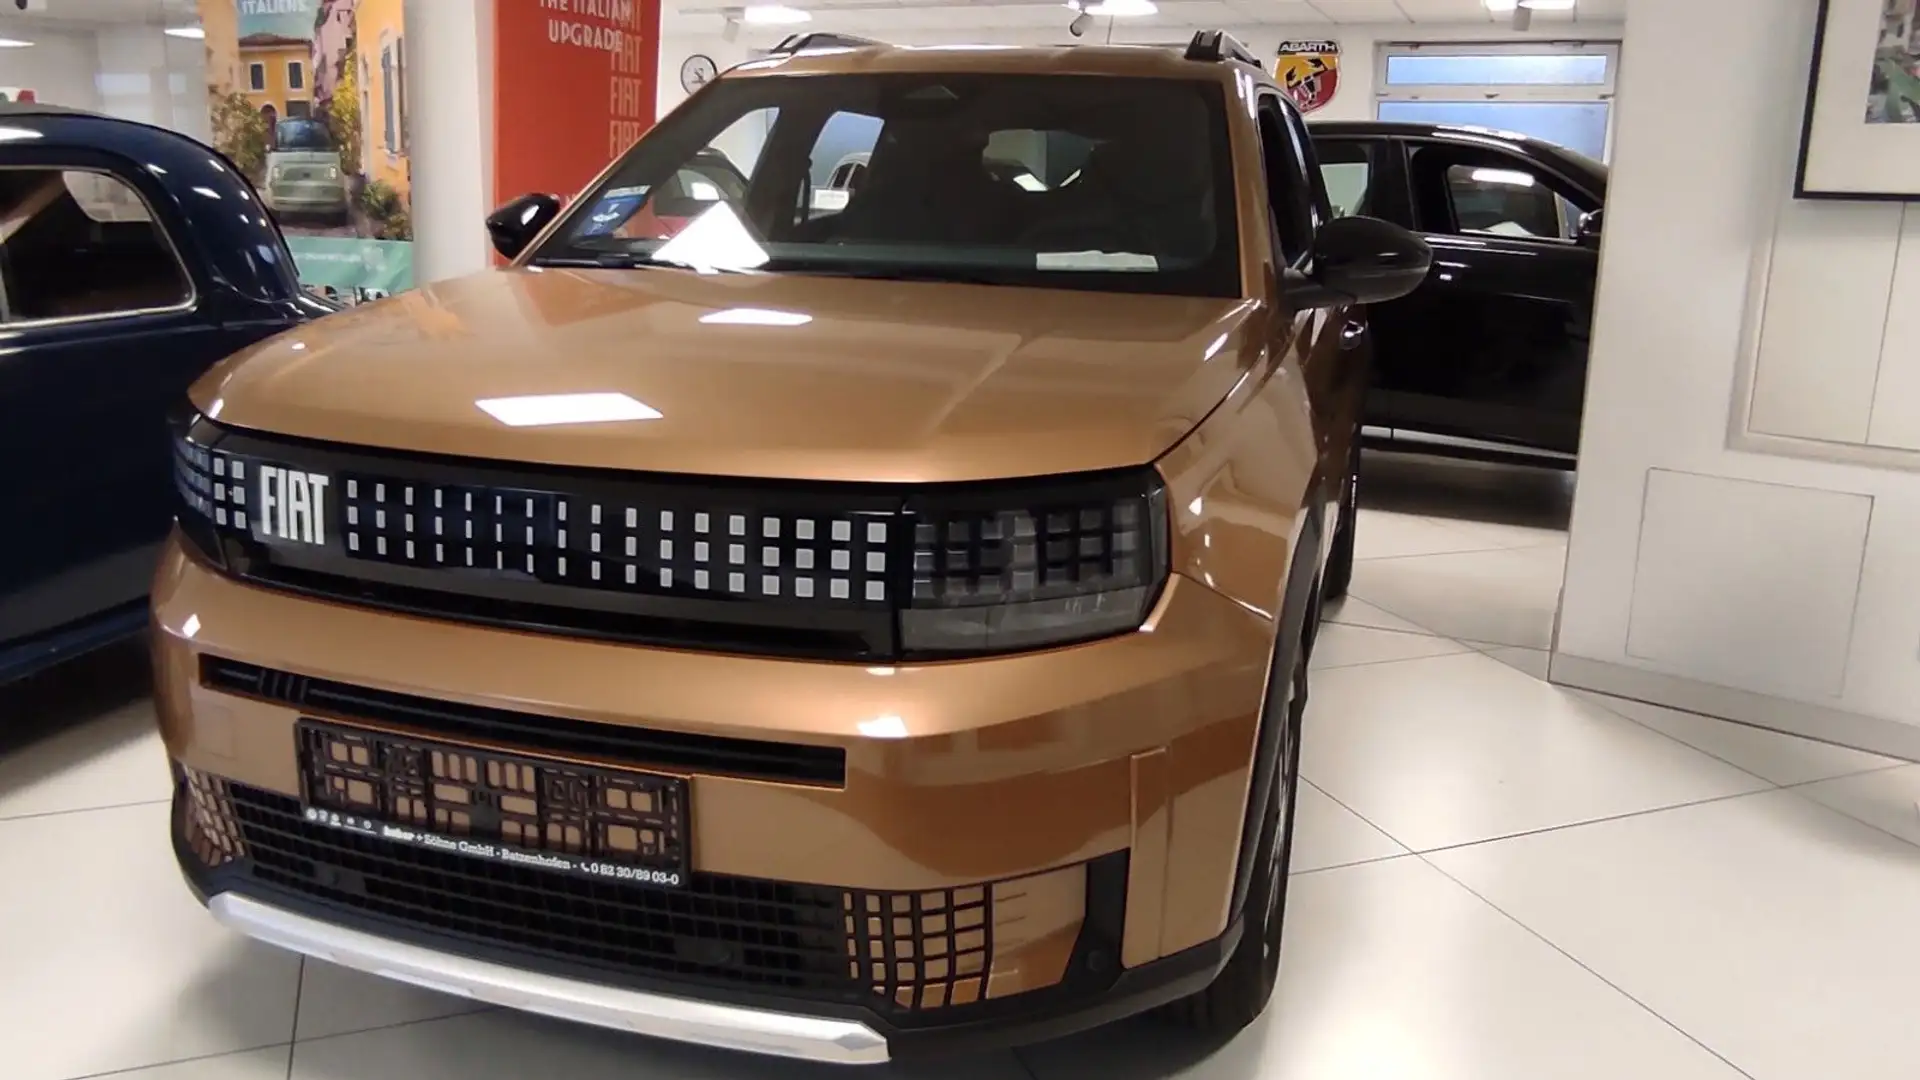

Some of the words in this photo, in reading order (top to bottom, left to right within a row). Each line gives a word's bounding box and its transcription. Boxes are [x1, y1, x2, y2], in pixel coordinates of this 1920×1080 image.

[548, 19, 622, 52] UPGRADE
[1280, 43, 1335, 52] ABARTH
[610, 76, 642, 118] FIAT
[261, 465, 329, 545] FIAT
[459, 841, 494, 857] GmbH
[591, 864, 599, 875] 0
[652, 871, 679, 885] 03-0
